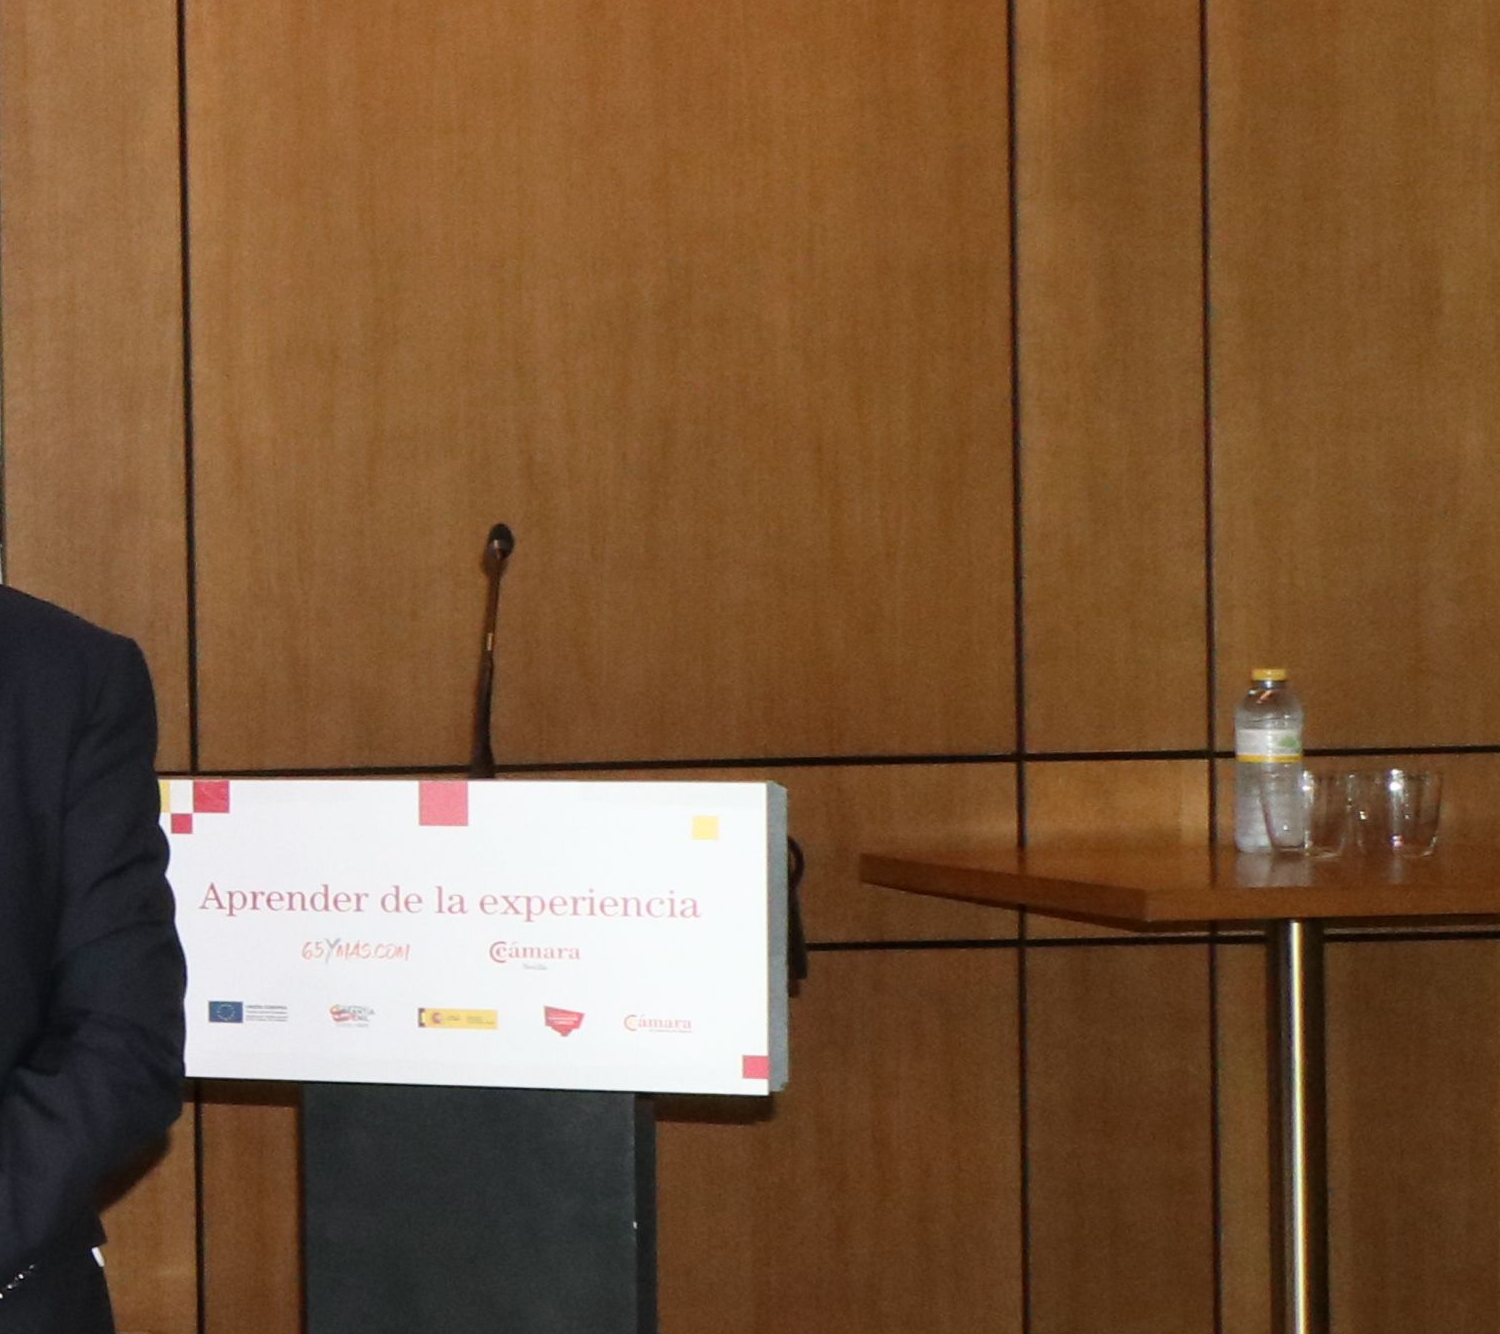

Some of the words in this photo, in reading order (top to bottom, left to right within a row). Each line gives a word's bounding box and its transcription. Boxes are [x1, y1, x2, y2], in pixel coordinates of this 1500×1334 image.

[199, 881, 369, 917] Aprender
[381, 885, 423, 914] de
[436, 886, 468, 915] la
[479, 888, 701, 923] experiencia
